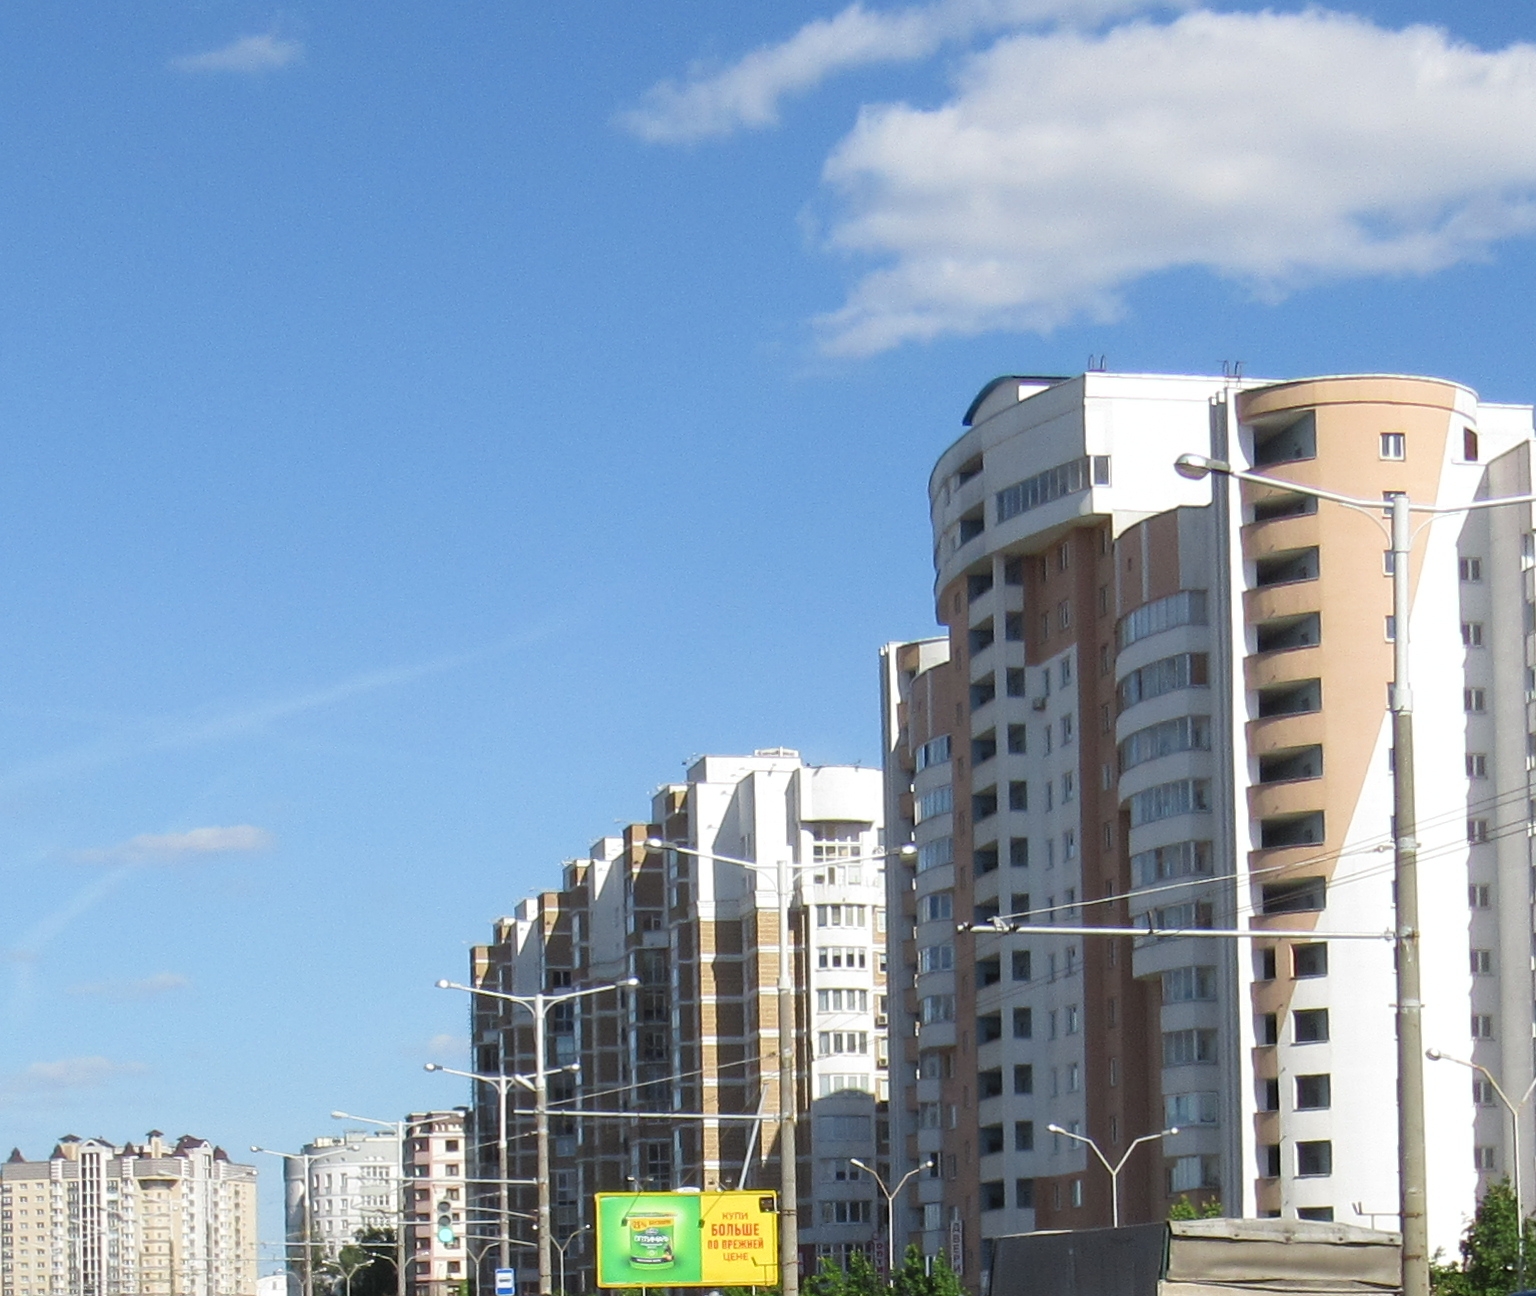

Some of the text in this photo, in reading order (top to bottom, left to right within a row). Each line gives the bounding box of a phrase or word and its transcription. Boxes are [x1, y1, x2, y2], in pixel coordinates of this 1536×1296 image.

[721, 1211, 749, 1221] КУПИ
[710, 1223, 760, 1237] БОЛЬШЕ
[707, 1237, 764, 1250] ПО ПРЕЖНЕЙ
[722, 1252, 749, 1262] ЦЕНЕ
